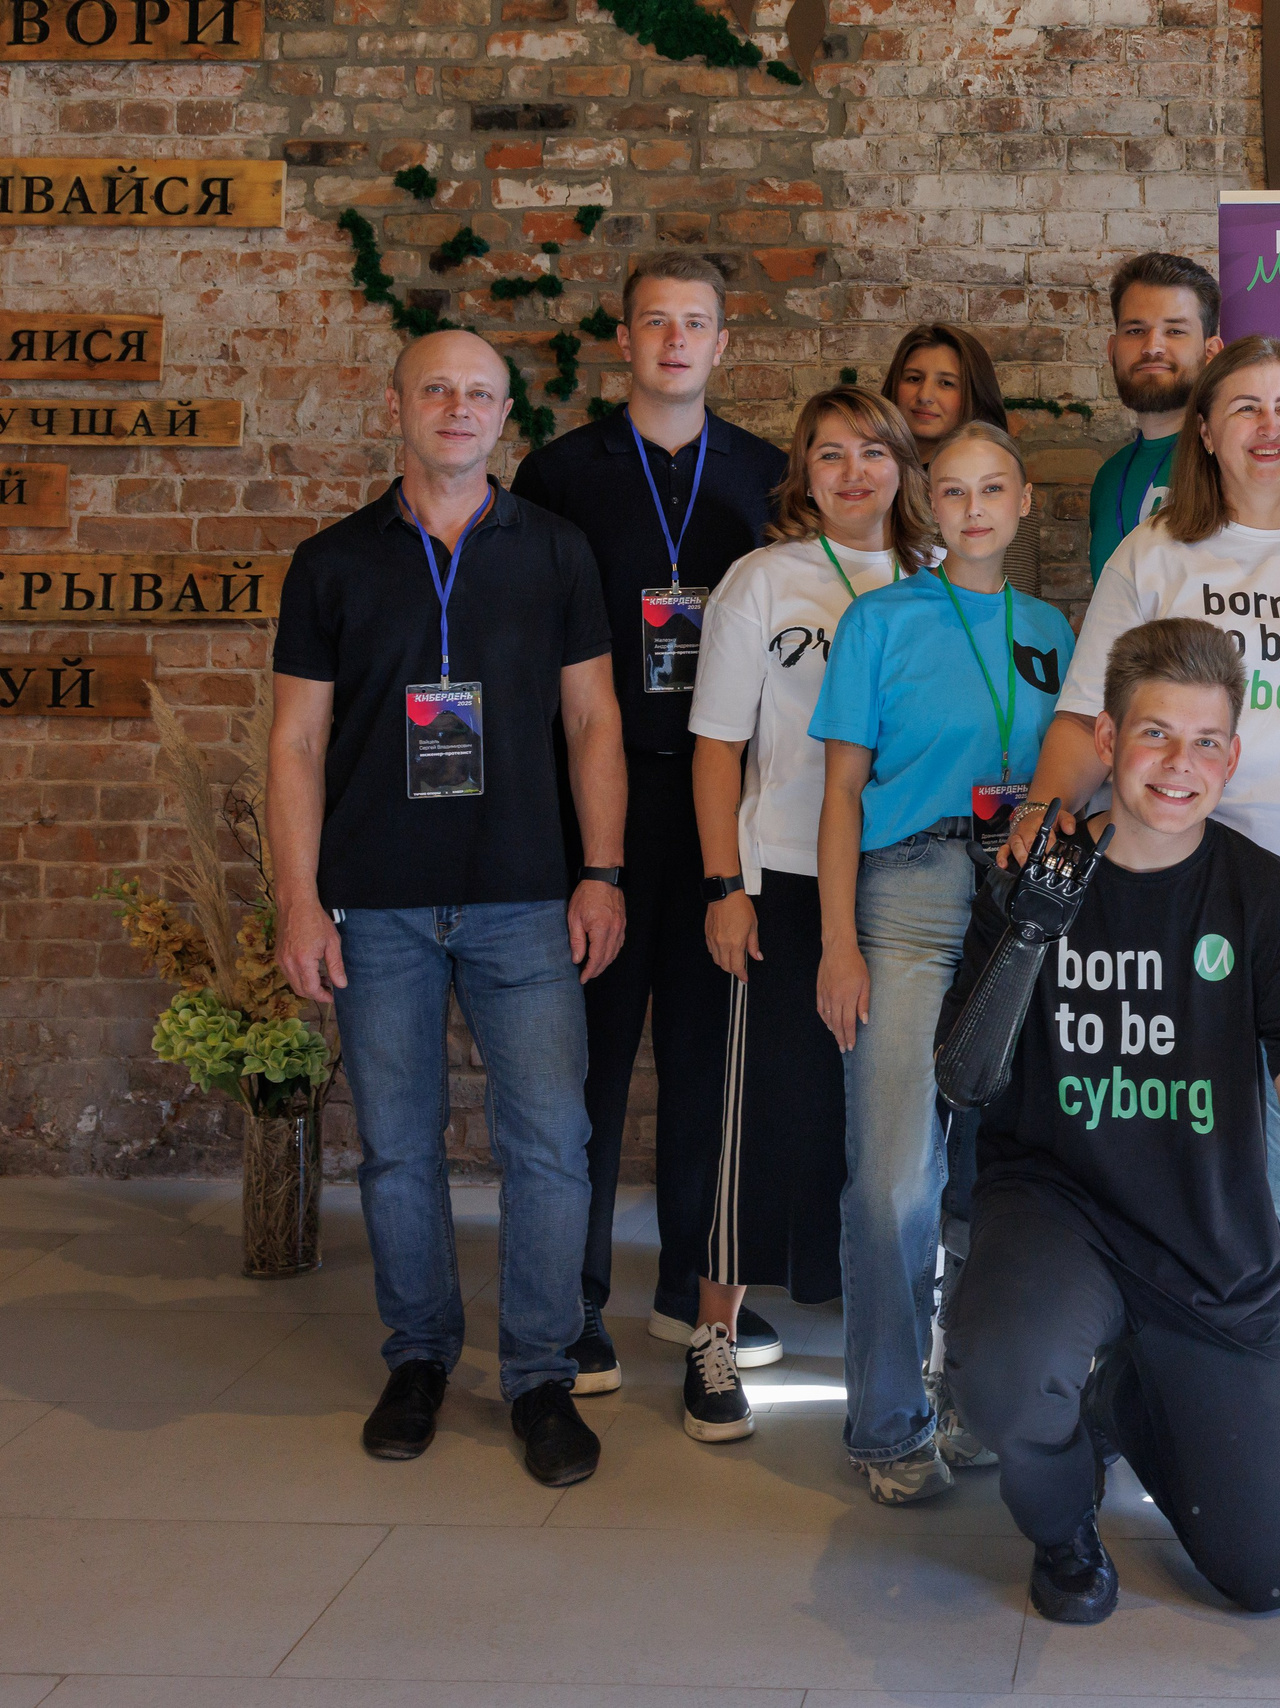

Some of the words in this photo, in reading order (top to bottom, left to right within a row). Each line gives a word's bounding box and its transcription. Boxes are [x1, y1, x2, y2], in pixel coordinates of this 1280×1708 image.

[6, 0, 240, 46] ВОРИ
[0, 561, 264, 613] РЫВАЙ
[0, 657, 96, 708] УЙ
[414, 692, 474, 702] КИБЕРДЕНЬ
[978, 785, 1028, 795] КИБЕРДЕНЬ
[1057, 936, 1163, 990] born
[1055, 1003, 1104, 1054] to
[1120, 1001, 1176, 1056] be
[1058, 1066, 1215, 1134] cyborg
